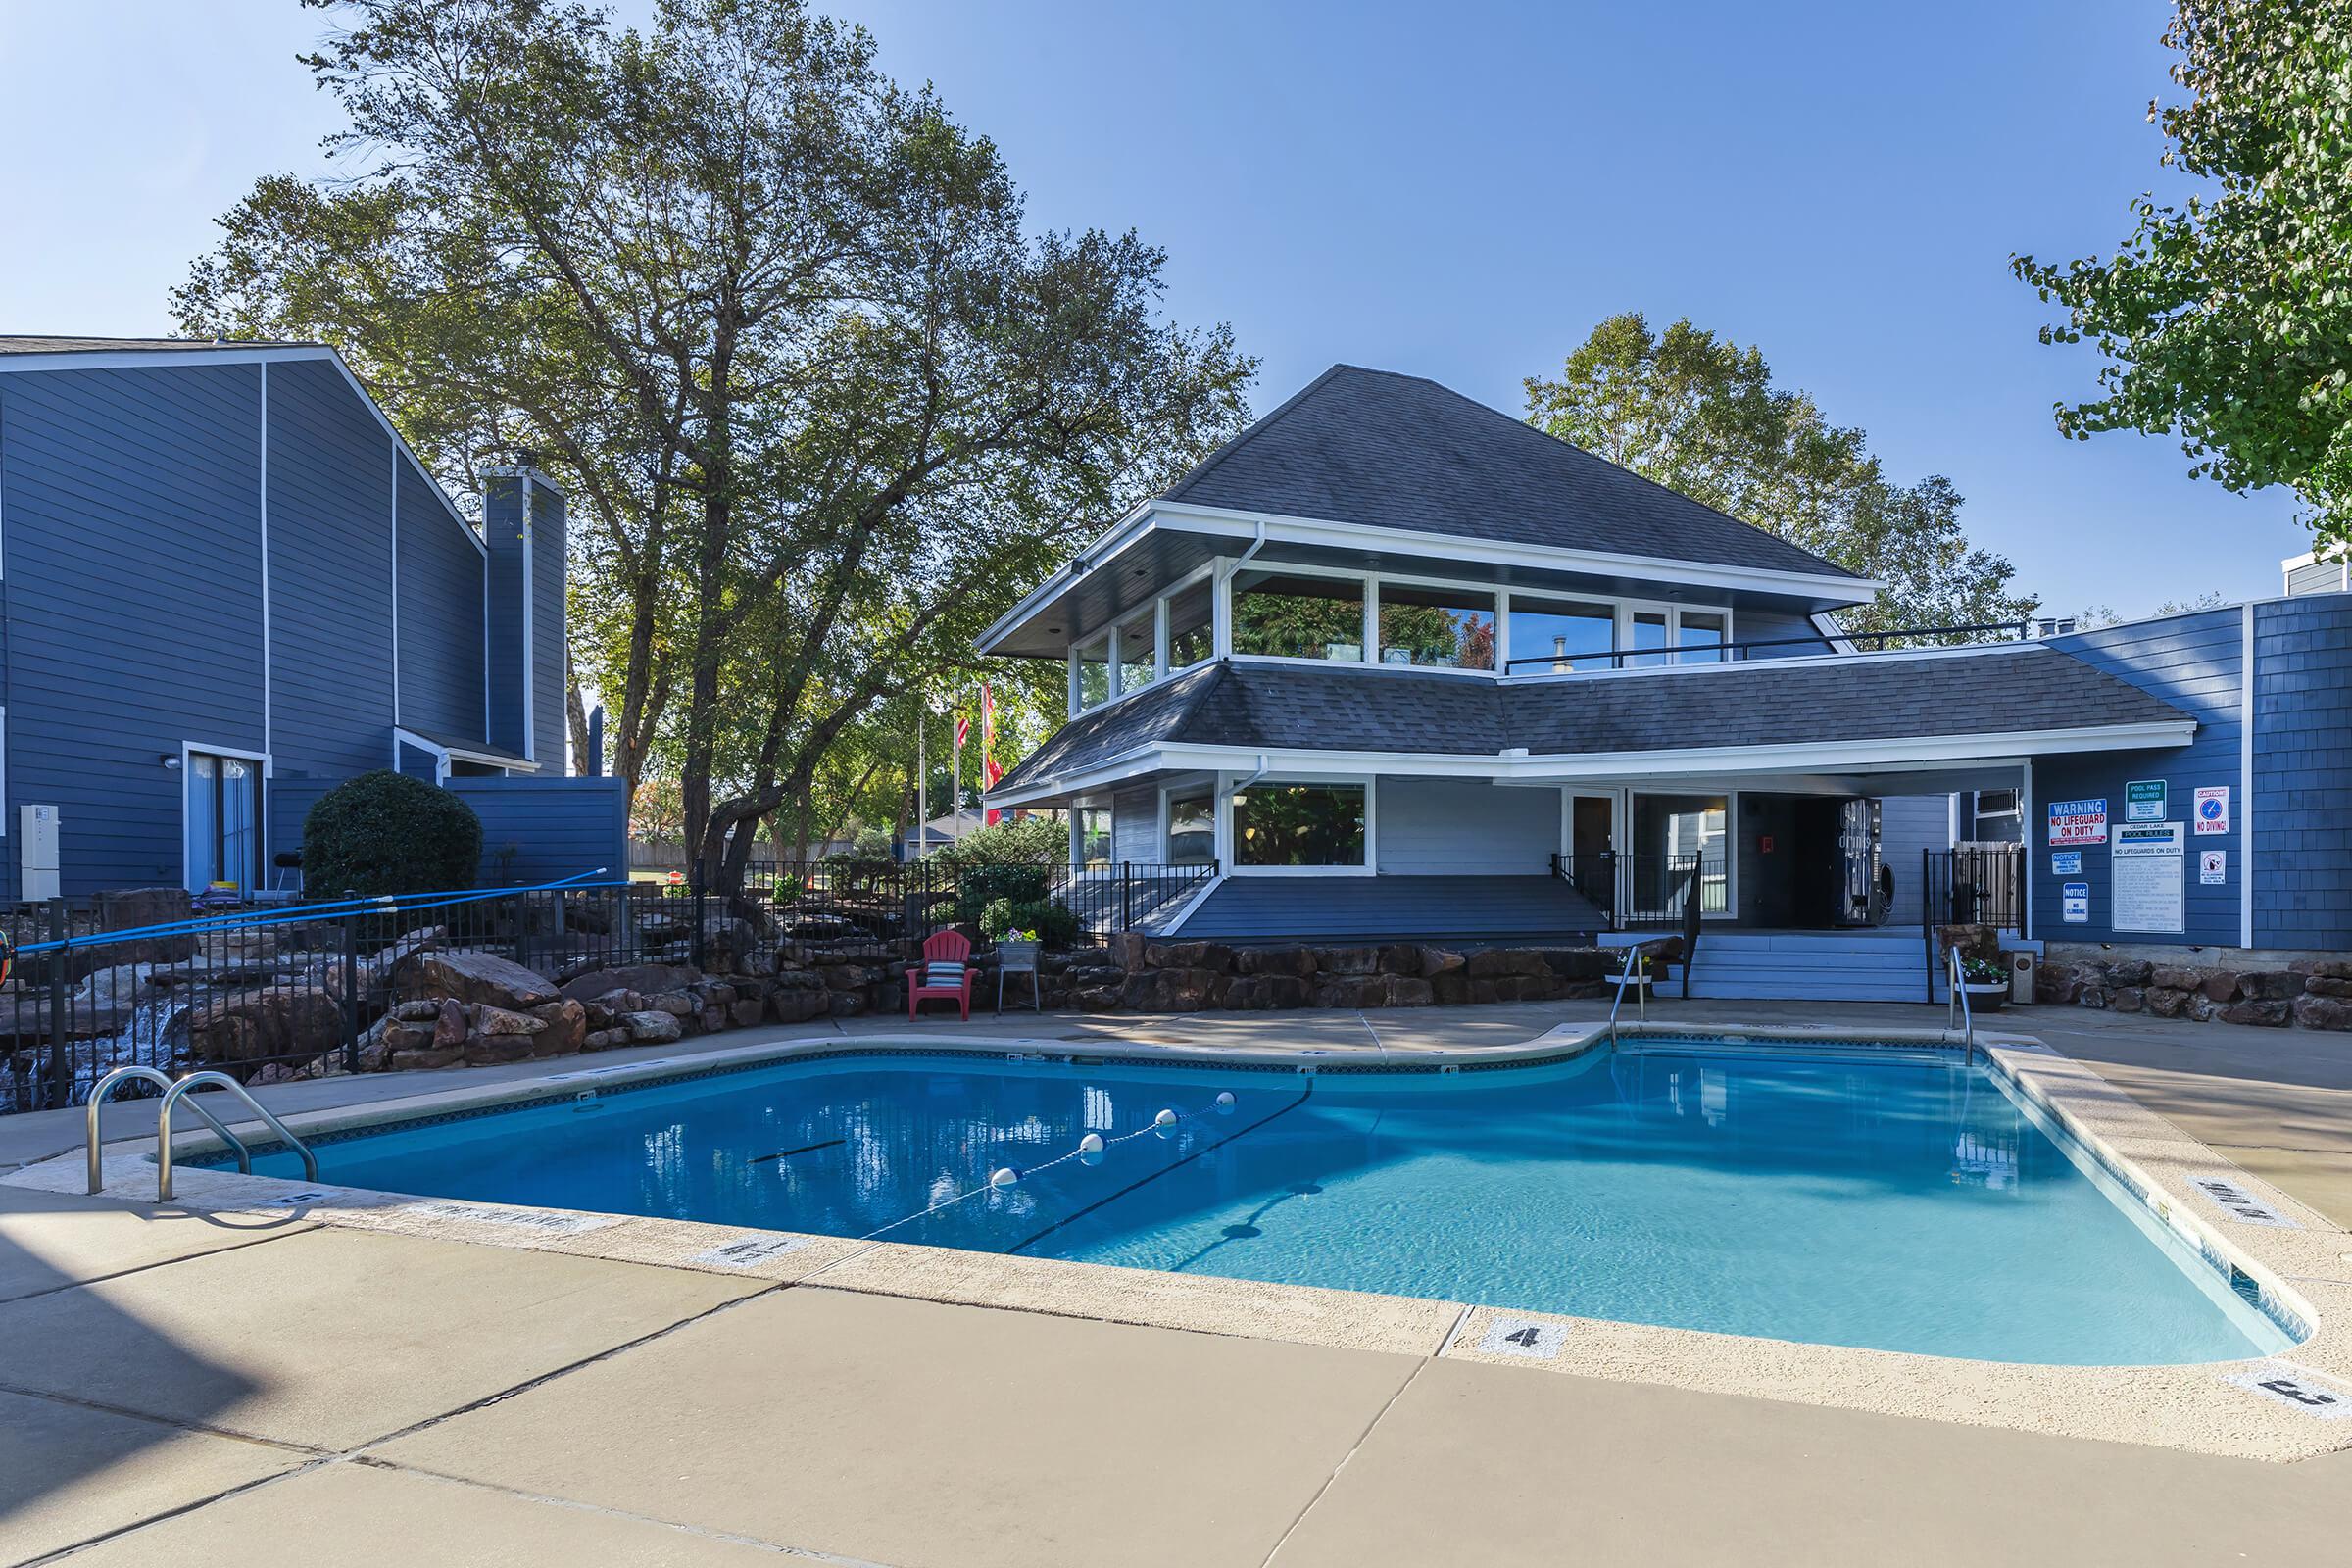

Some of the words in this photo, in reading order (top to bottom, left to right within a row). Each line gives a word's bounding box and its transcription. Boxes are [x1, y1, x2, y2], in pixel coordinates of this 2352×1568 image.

[2053, 801, 2102, 815] WARNING
[2051, 817, 2061, 826] NO
[2064, 814, 2105, 826] LIFEGUARD
[2197, 821, 2205, 831] NO
[2061, 827, 2072, 837] ON
[2074, 825, 2094, 836] DUTY
[1839, 831, 1871, 849] drins
[2065, 888, 2086, 897] NOTICE
[1504, 1327, 1541, 1348] 4
